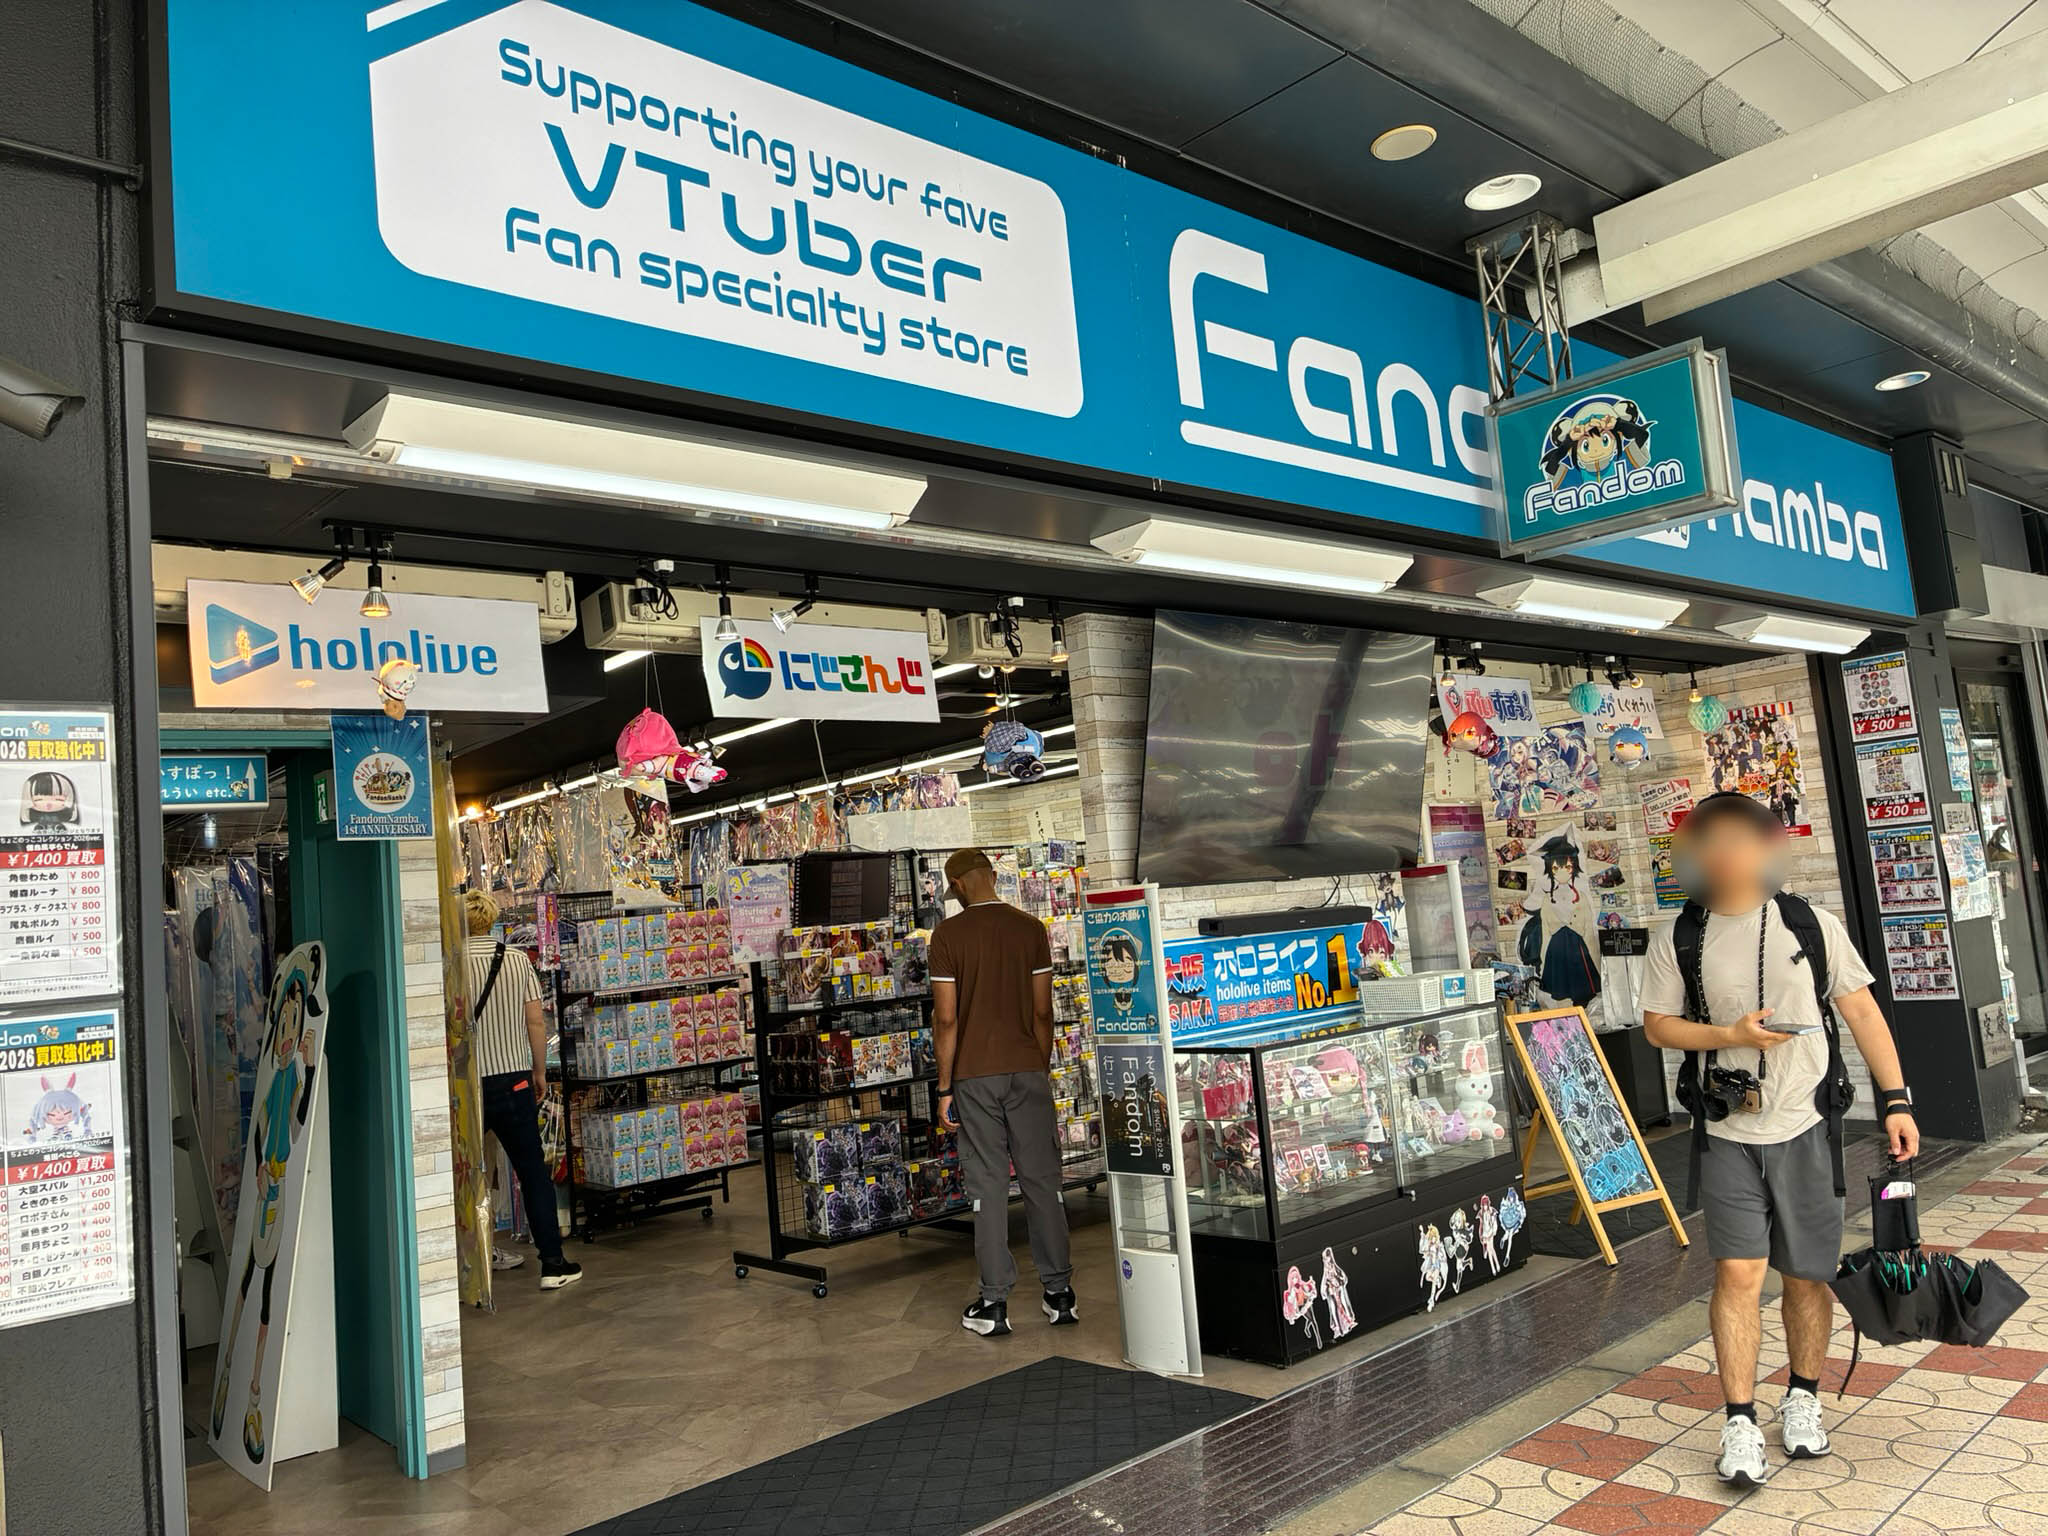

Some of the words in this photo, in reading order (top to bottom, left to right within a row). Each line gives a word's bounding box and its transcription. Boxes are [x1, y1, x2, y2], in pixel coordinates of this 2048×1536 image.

[498, 38, 796, 181] Supporting
[808, 150, 907, 205] your
[921, 181, 1009, 242] fave
[543, 121, 982, 303] VTuber
[505, 206, 620, 279] Fan
[640, 250, 886, 356] specialty
[900, 316, 1028, 377] store
[1524, 459, 1685, 523] Fandom
[1707, 478, 1889, 571] amba
[289, 624, 498, 677] hololive
[780, 649, 927, 695] にじさんじ
[1871, 719, 1895, 732] 500
[206, 788, 232, 798] etc.
[350, 813, 419, 825] FandomNamba
[1884, 805, 1909, 818] 500
[345, 824, 359, 835] 1st
[362, 823, 427, 835] ANNIVERSARY
[65, 851, 96, 865] 買取
[81, 871, 99, 879] 800
[729, 871, 752, 893] 3F
[81, 886, 100, 895] 800
[82, 901, 100, 910] 800
[83, 916, 101, 925] 500
[1087, 909, 1146, 925] ご協力のお願い
[83, 931, 101, 940] 500
[84, 946, 102, 956] 500
[1213, 936, 1319, 982] ホロライブ
[1294, 933, 1360, 1012] No.1
[1216, 982, 1260, 1001] hololive
[1263, 978, 1292, 997] items
[1169, 998, 1216, 1031] SAKA
[1096, 1017, 1147, 1032] Fandom
[0, 1048, 35, 1069] 2026
[1122, 1056, 1143, 1157] Fandom
[1154, 1108, 1162, 1133] SINCE
[1156, 1138, 1164, 1158] 2024
[75, 1155, 105, 1174] 買取
[91, 1188, 110, 1198] 600
[92, 1201, 110, 1212] 400
[92, 1215, 111, 1225] 400
[92, 1229, 111, 1239] 400
